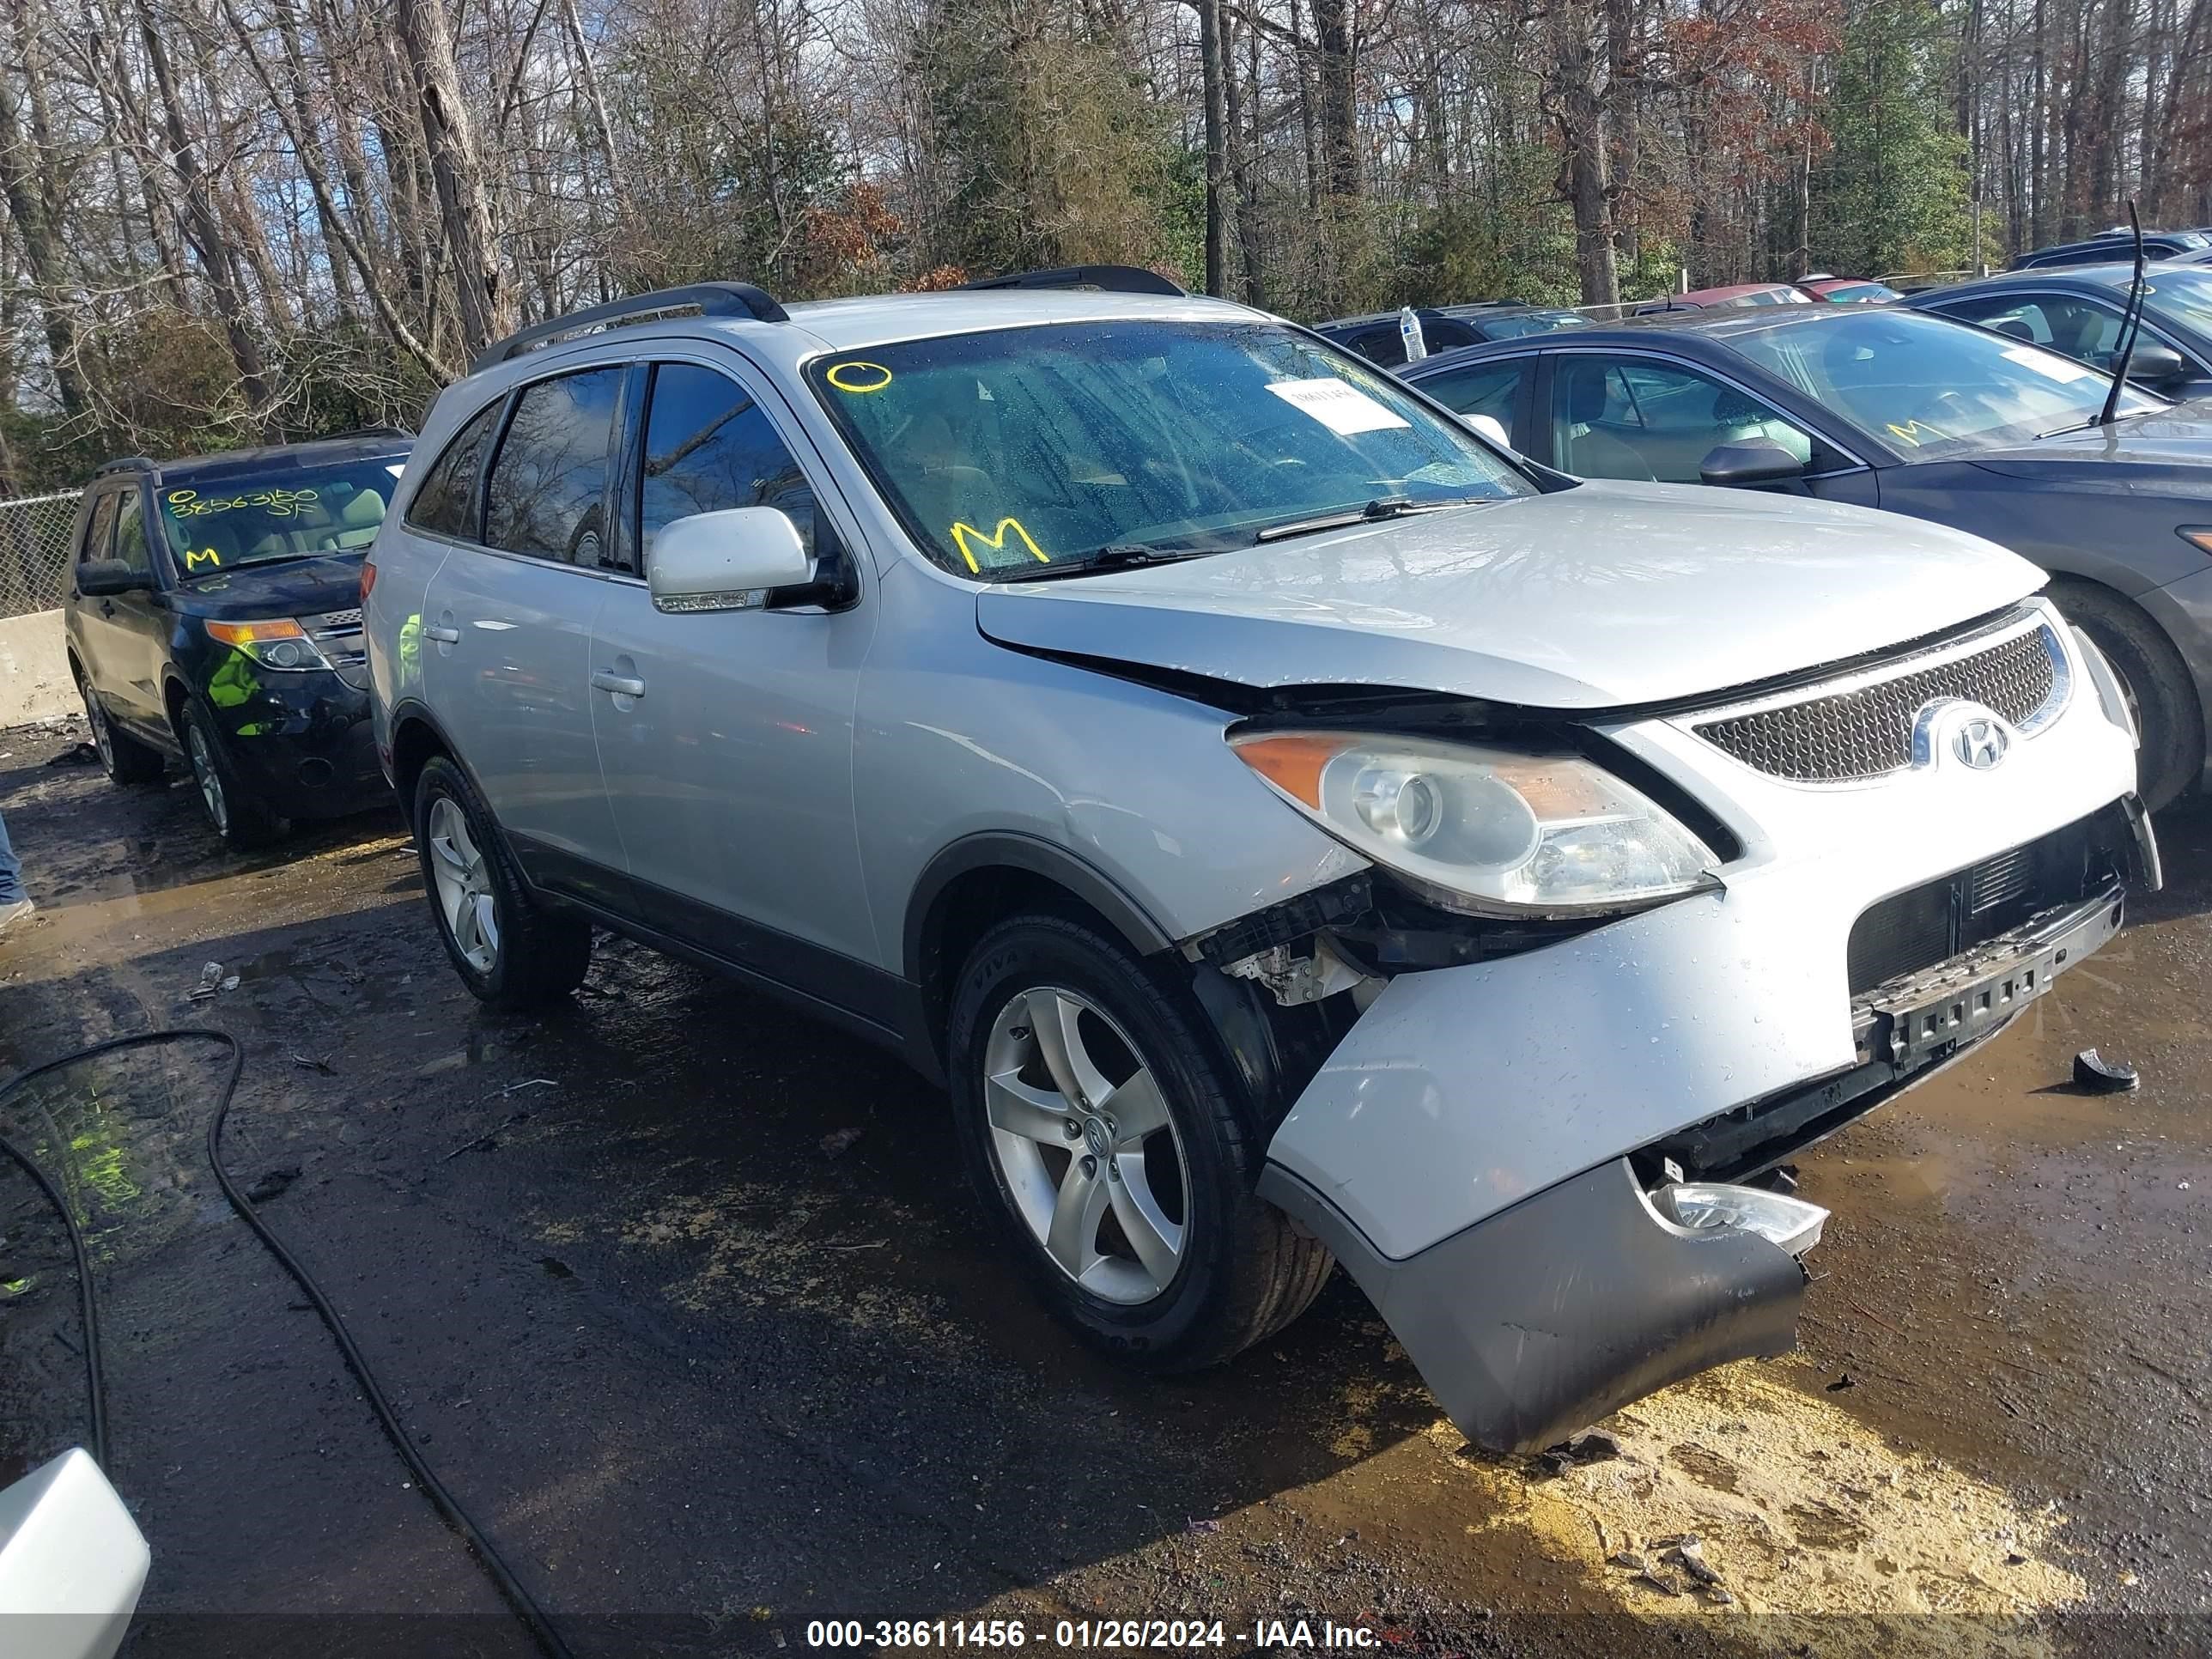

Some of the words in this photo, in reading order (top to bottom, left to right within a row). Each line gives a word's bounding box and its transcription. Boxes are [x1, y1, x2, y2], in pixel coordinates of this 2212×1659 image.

[1887, 420, 1959, 447] M
[169, 489, 319, 519] 38563150
[185, 547, 221, 571] M
[950, 516, 1050, 574] M
[974, 950, 1019, 989] VIVA
